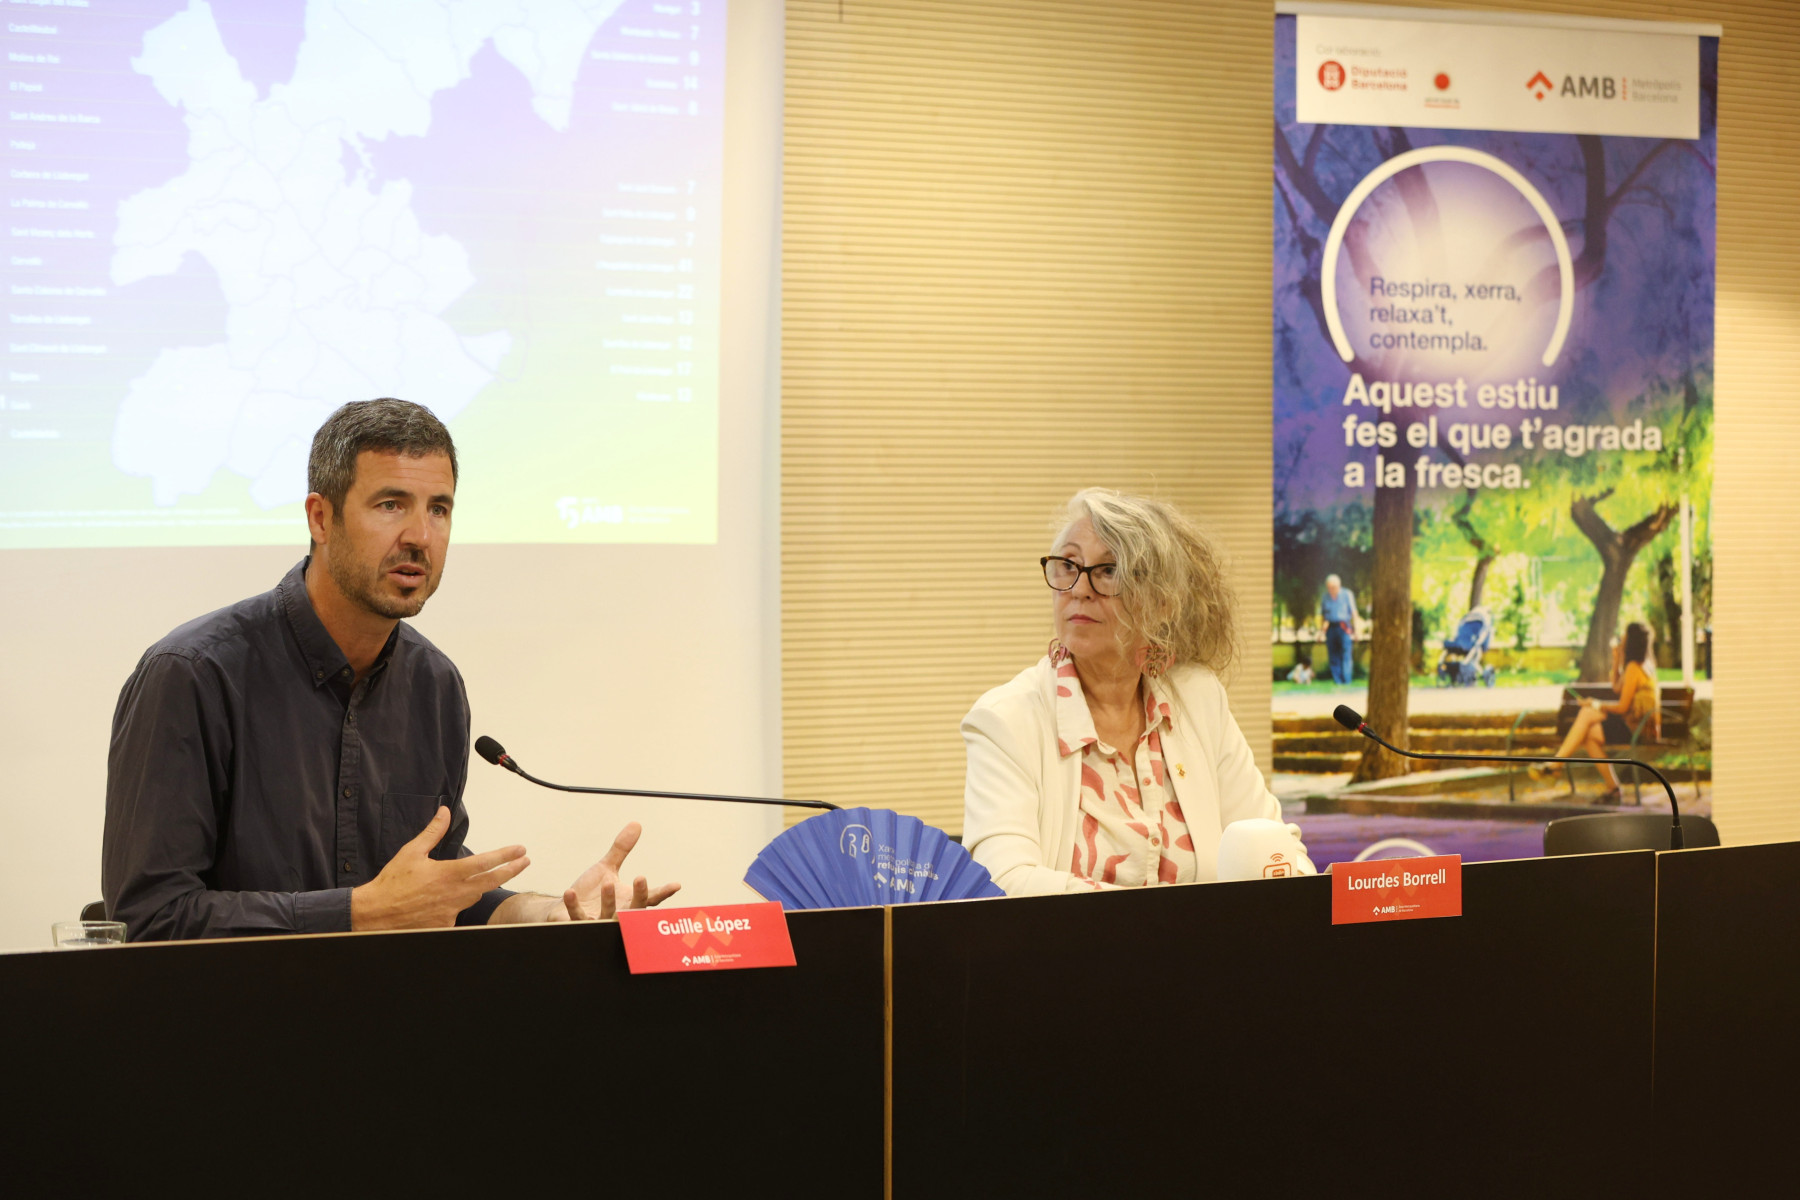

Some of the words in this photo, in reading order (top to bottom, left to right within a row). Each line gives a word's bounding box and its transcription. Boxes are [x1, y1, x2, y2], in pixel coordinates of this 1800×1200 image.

[1352, 80, 1407, 91] Barcelona
[1560, 75, 1616, 99] AMB
[1370, 277, 1457, 301] Respira,
[1465, 283, 1521, 302] xerra,
[1370, 304, 1452, 326] relaxa't,
[1370, 332, 1487, 353] contempla.
[1342, 373, 1468, 414] Aquest
[1477, 377, 1559, 410] estiu
[1342, 414, 1397, 447] fes
[1406, 415, 1437, 448] el
[1448, 423, 1511, 455] que
[1520, 417, 1662, 457] t'agrada
[1343, 462, 1365, 488] a
[1375, 455, 1405, 488] la
[1415, 456, 1531, 488] fresca.
[1348, 873, 1400, 891] Lourdes
[1403, 868, 1446, 887] Borrell
[1381, 905, 1396, 914] AMB
[657, 918, 703, 936] Guille
[705, 916, 751, 934] López
[692, 955, 711, 965] AMB
